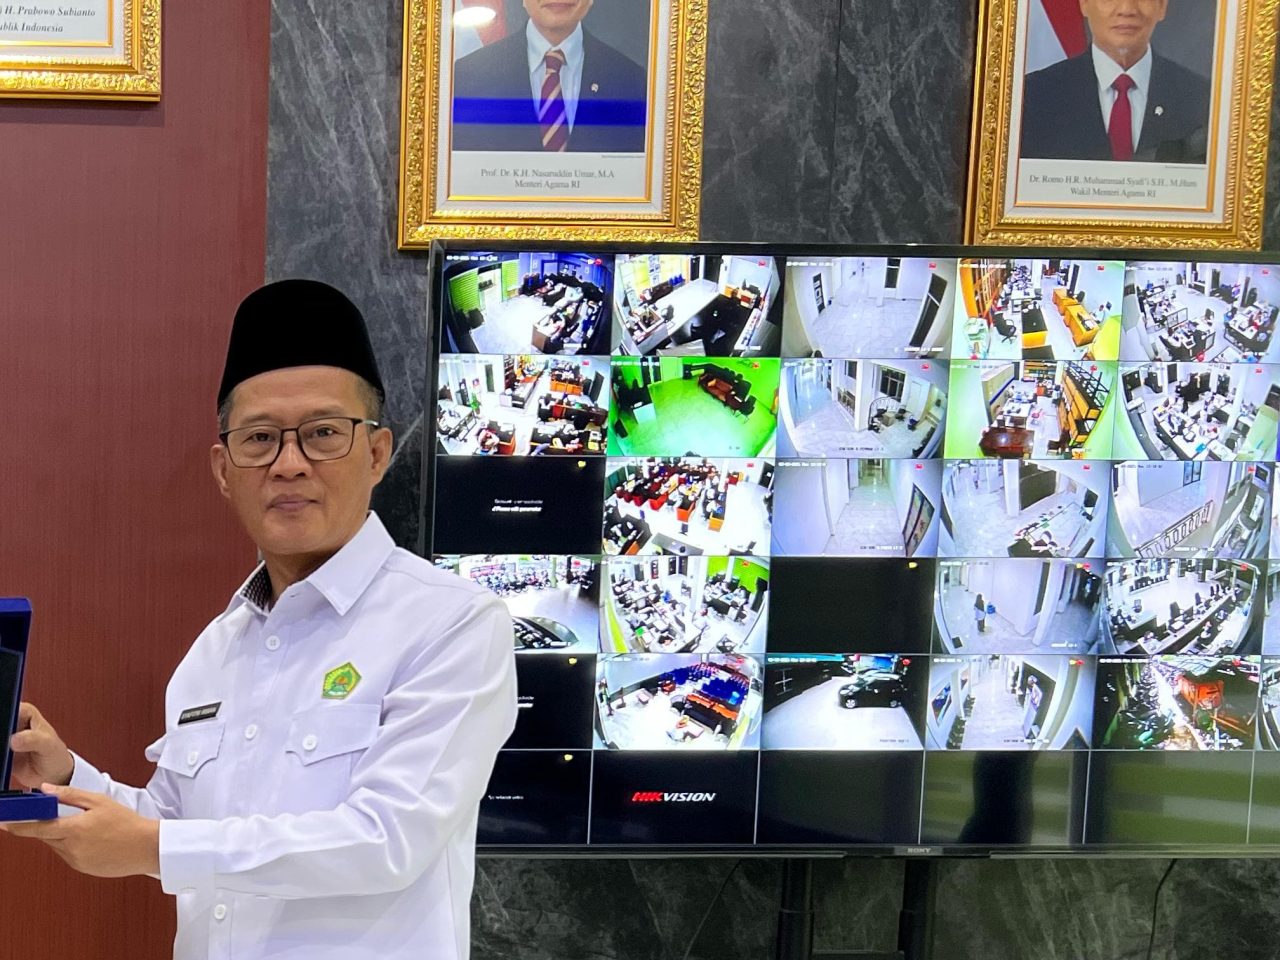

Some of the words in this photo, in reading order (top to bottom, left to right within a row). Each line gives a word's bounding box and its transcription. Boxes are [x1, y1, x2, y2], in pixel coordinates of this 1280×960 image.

[5, 5, 15, 15] H.
[18, 6, 55, 16] Prabowo
[57, 7, 96, 17] Subianto
[21, 22, 64, 32] Indonesia
[532, 169, 573, 178] Nasaruddin
[514, 180, 543, 188] Menteri
[544, 181, 569, 190] Agama
[571, 181, 580, 189] RI
[1042, 175, 1064, 183] Romo
[1083, 176, 1125, 185] Muhammad
[1070, 187, 1090, 196] Wakil
[1121, 189, 1145, 199] Agama
[1147, 190, 1156, 198] RI
[632, 791, 716, 802] HIKVISION
